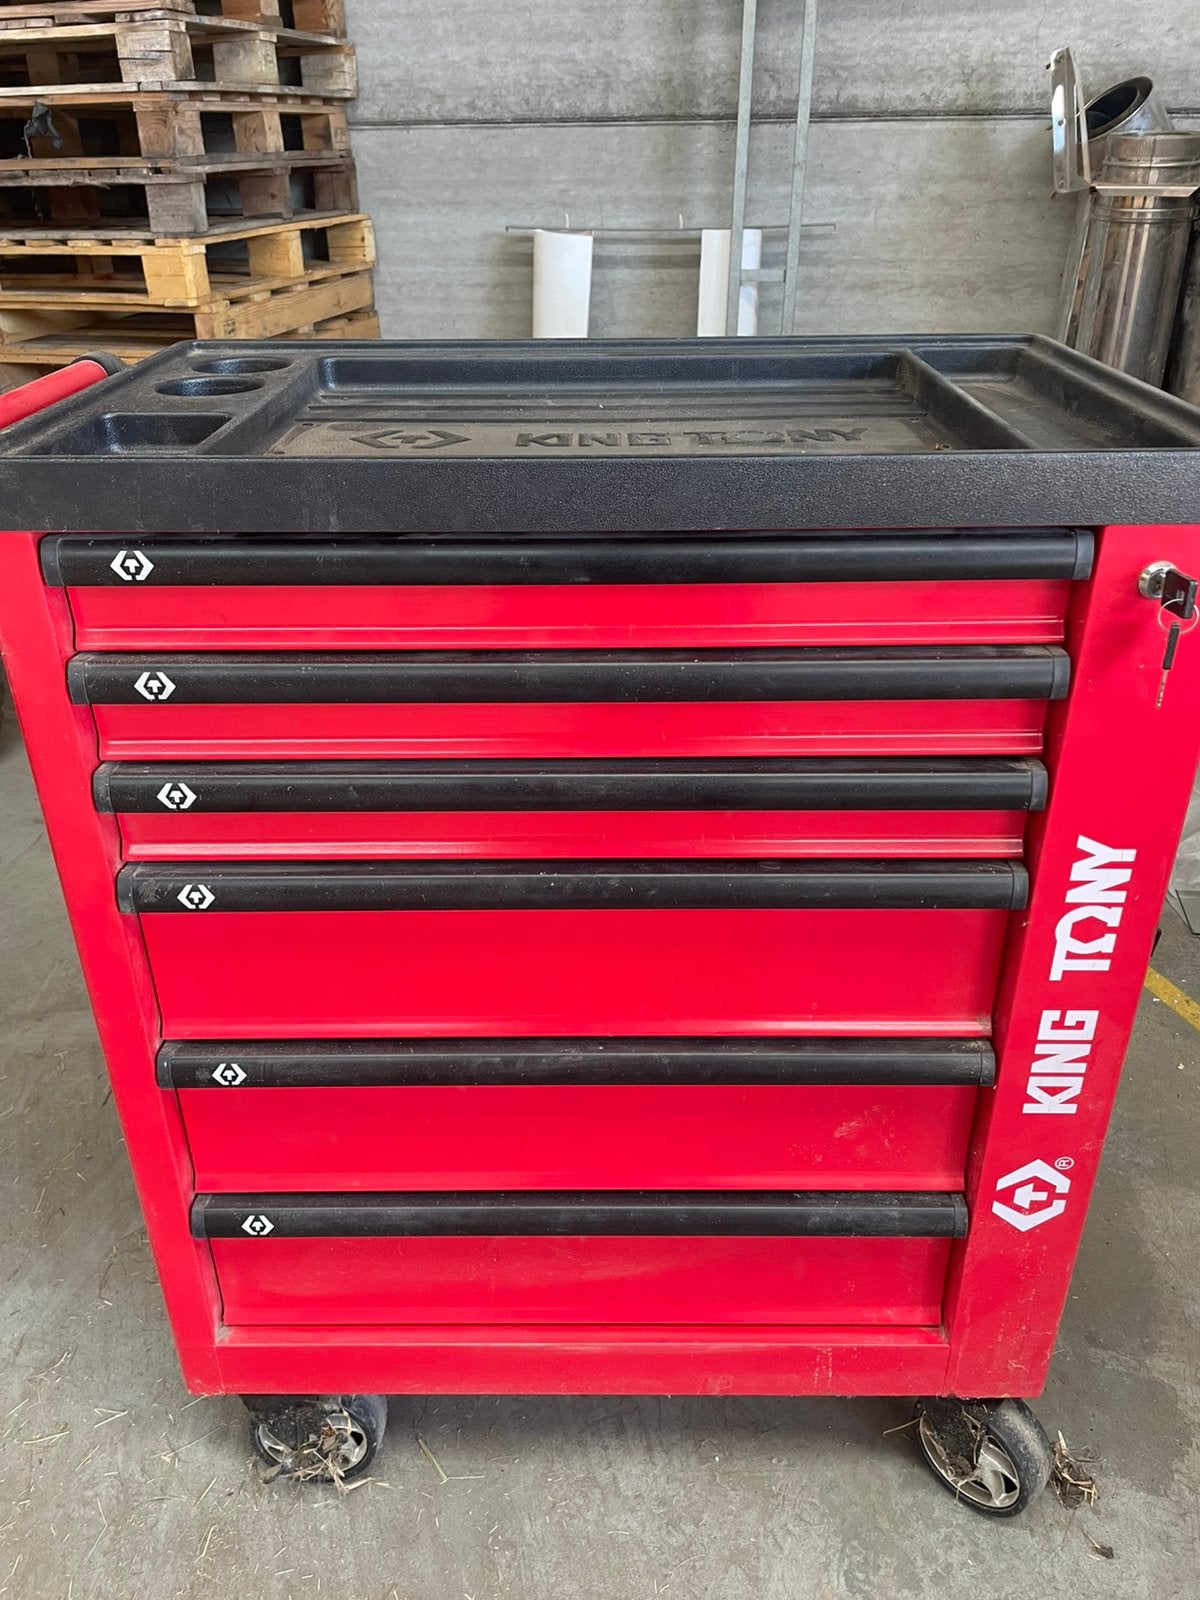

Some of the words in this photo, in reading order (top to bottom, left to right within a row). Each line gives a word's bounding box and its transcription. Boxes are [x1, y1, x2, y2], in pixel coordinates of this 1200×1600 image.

[514, 432, 671, 447] KING
[683, 427, 868, 445] TONY
[1049, 835, 1137, 981] TONY
[1022, 1010, 1099, 1114] KING
